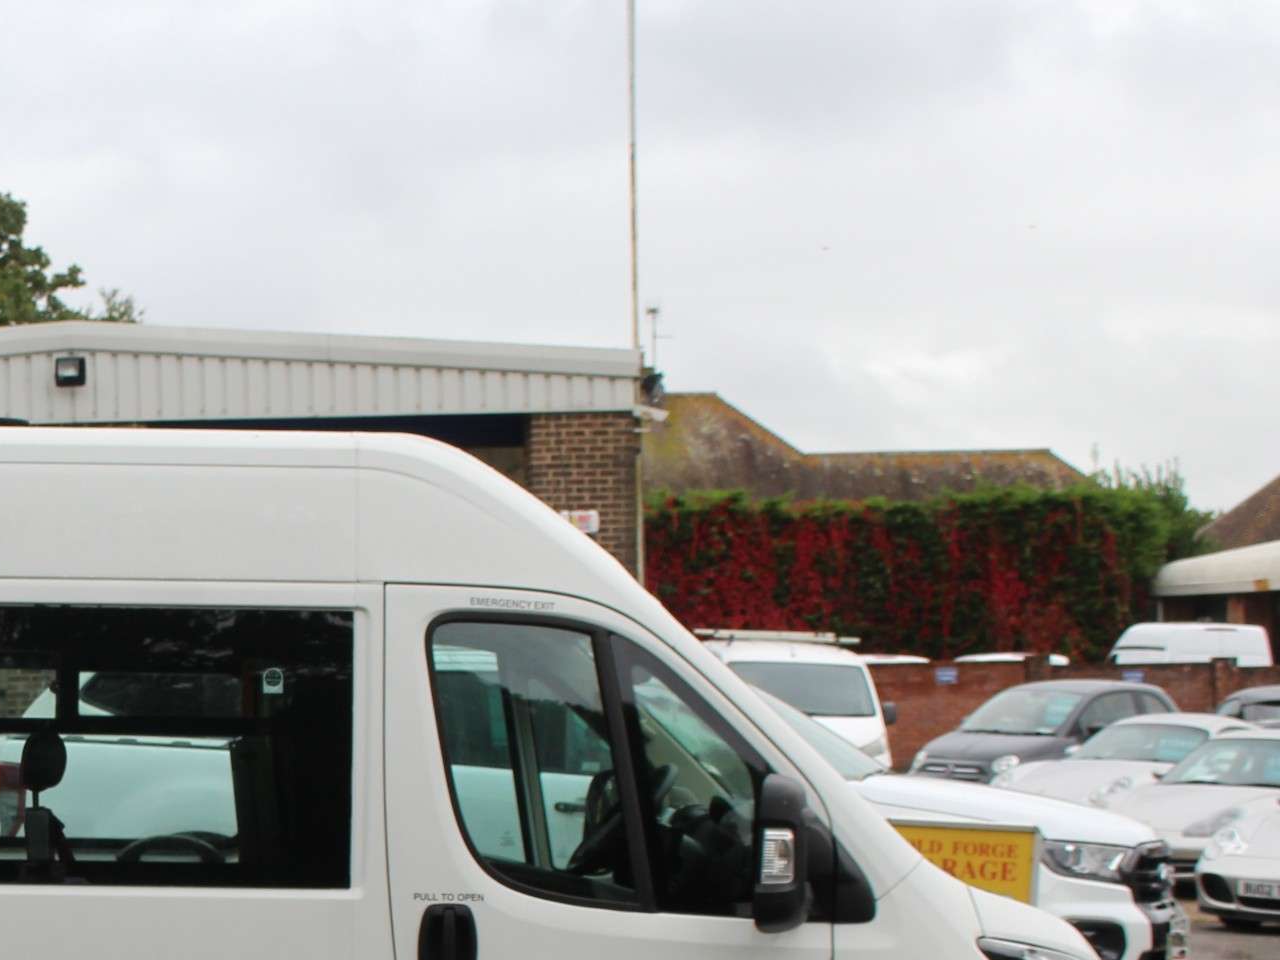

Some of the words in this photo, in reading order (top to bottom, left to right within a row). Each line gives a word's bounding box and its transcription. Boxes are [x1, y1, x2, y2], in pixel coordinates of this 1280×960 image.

[470, 596, 532, 609] EMERGENCY
[951, 841, 1018, 859] FORGE
[413, 892, 439, 901] PULL
[440, 893, 454, 902] TO
[457, 893, 485, 902] OPEN
